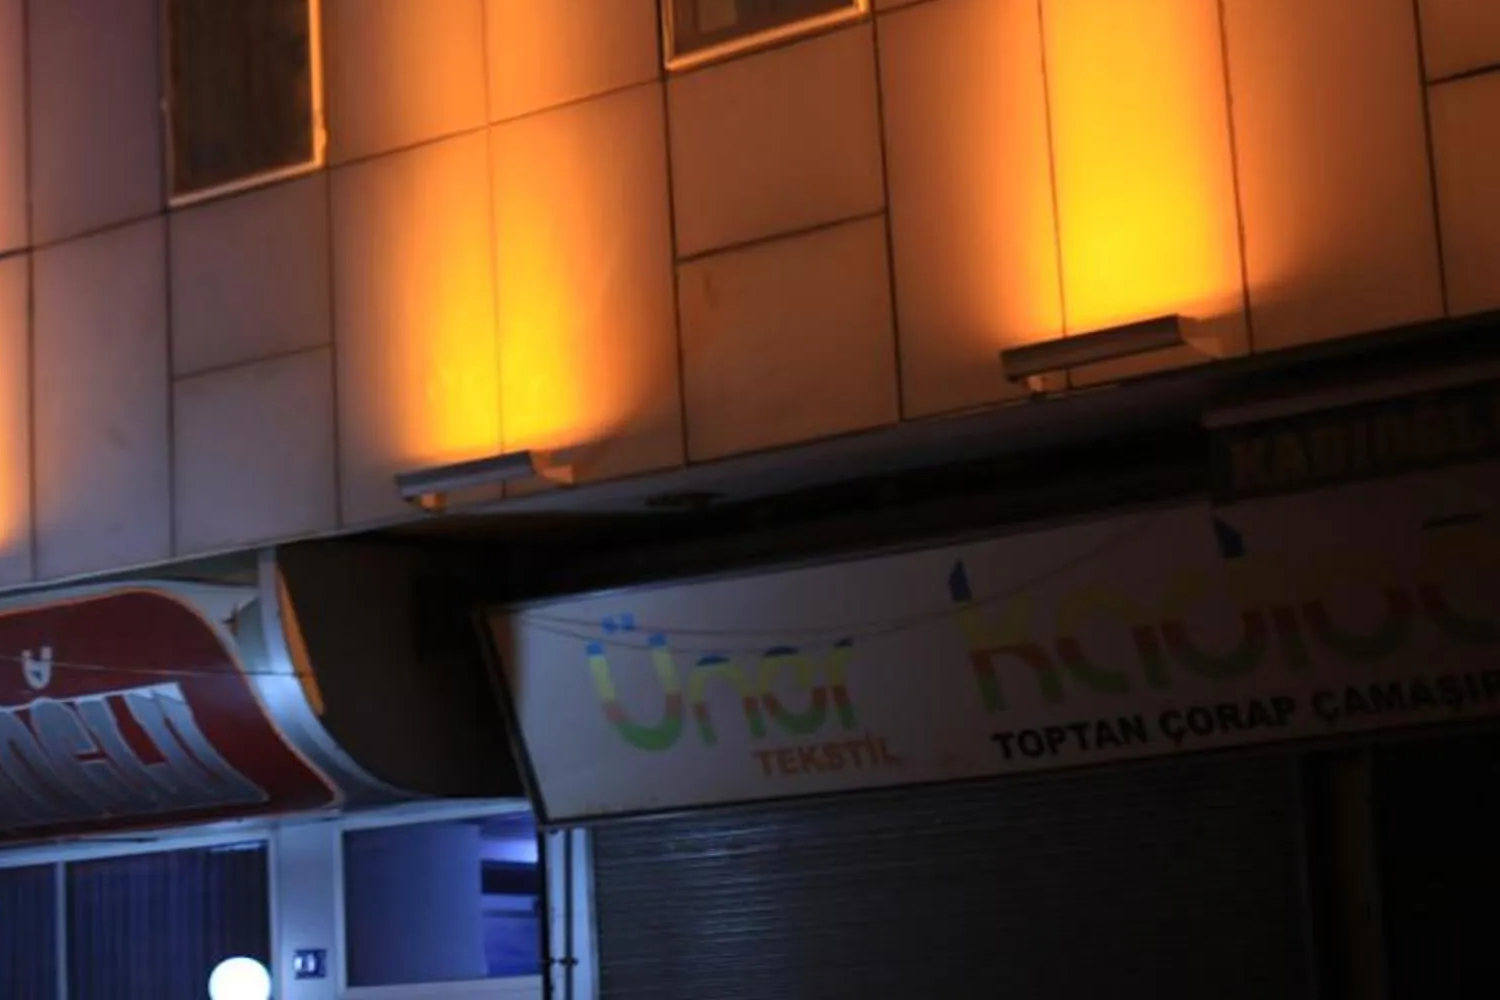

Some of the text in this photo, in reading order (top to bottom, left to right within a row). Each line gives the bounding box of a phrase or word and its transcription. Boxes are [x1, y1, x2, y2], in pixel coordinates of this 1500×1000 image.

[754, 732, 903, 778] TEKSTİL
[992, 714, 1148, 760] TOPTAN
[1159, 694, 1297, 746] ÇORAP
